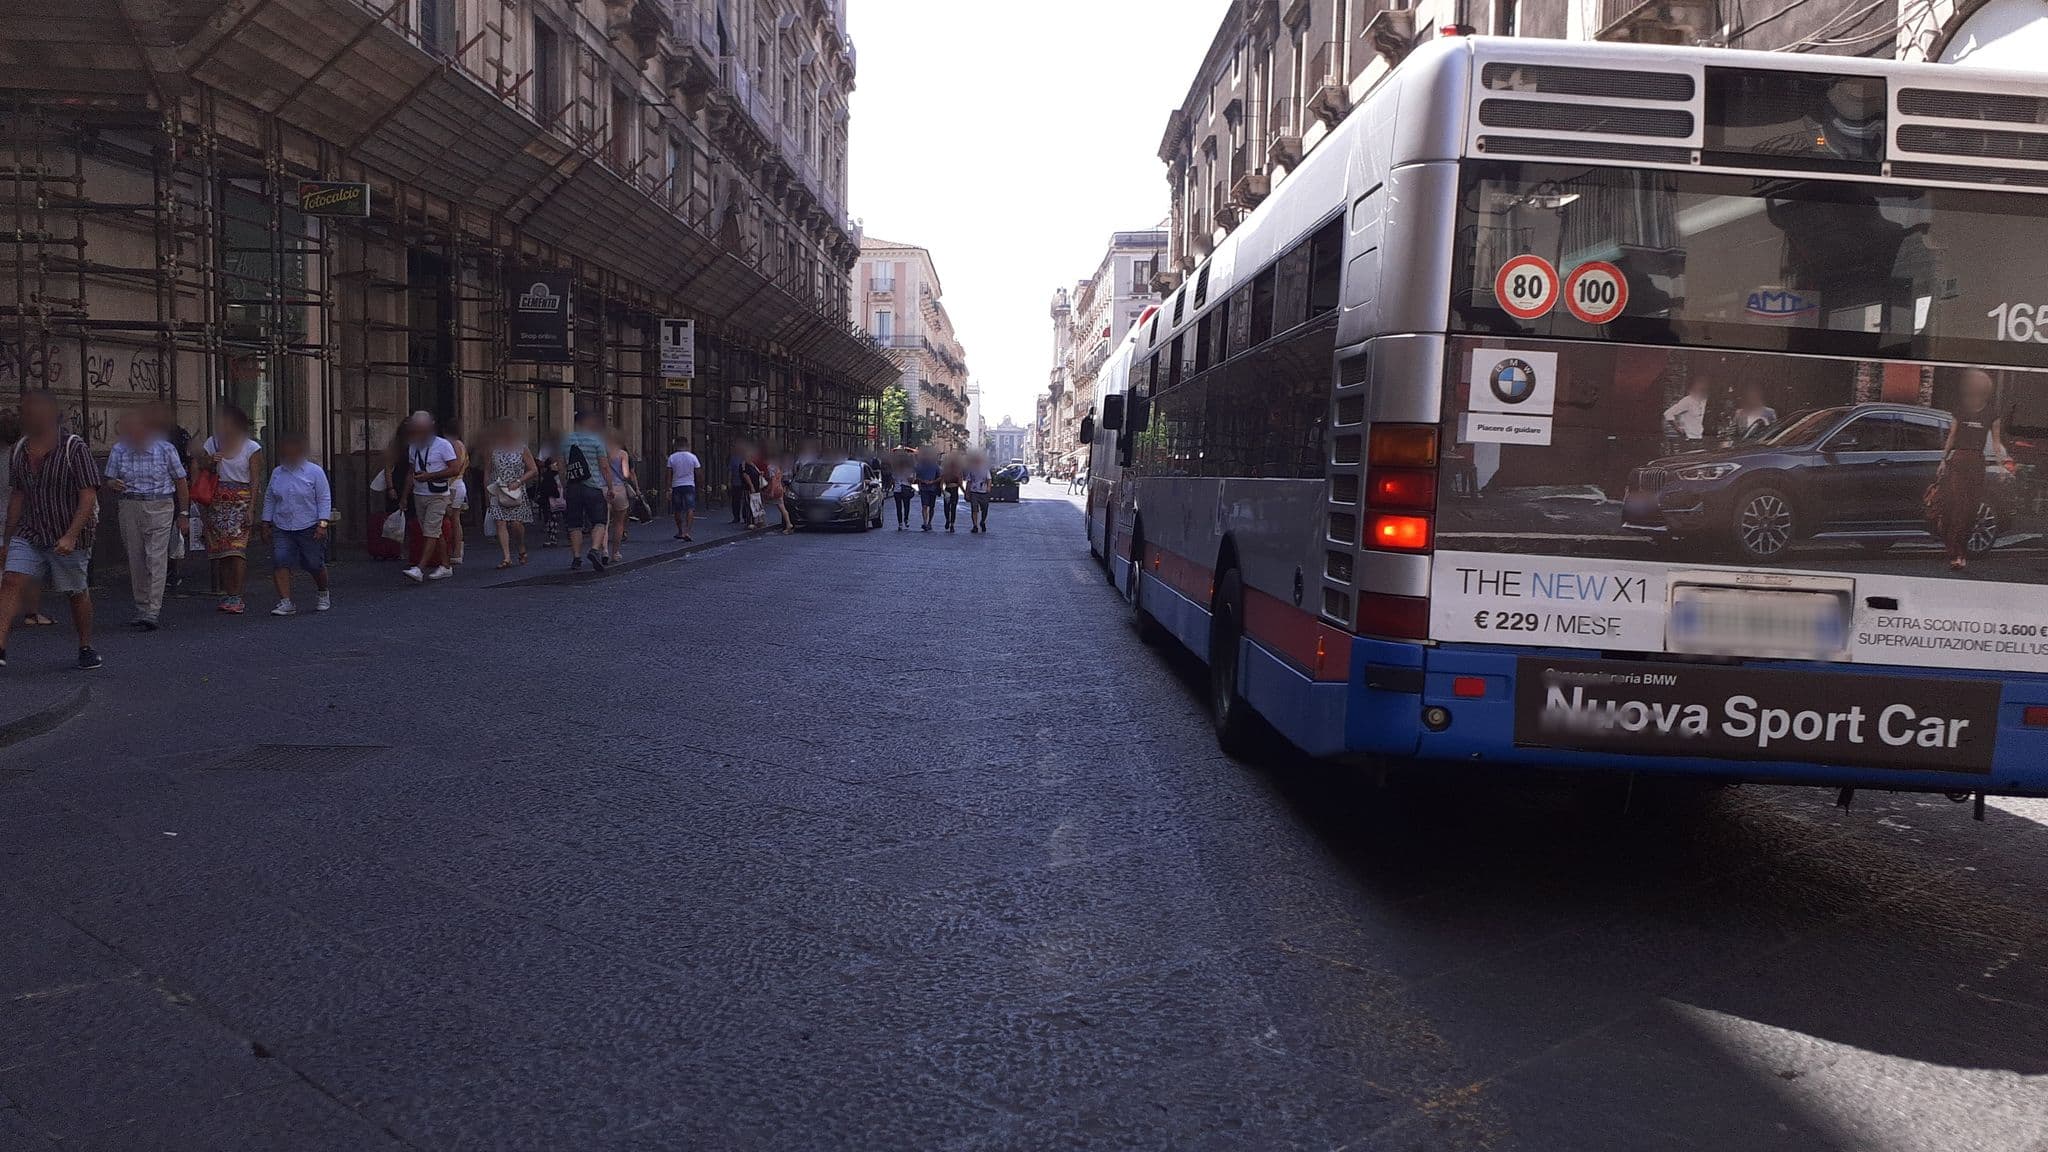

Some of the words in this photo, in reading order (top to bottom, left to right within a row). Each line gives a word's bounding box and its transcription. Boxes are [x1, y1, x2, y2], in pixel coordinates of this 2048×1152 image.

[303, 187, 361, 210] Totocalcio
[1513, 274, 1543, 299] 80
[1578, 279, 1616, 305] 100
[521, 297, 557, 309] CEMENTO
[1496, 359, 1533, 375] BMW
[1477, 423, 1505, 433] Piacere
[1505, 425, 1513, 433] di
[1513, 426, 1542, 435] guidare
[1456, 567, 1523, 598] THE
[1531, 572, 1608, 601] NEW
[1612, 576, 1647, 604] X1
[1474, 610, 1490, 630] €
[1495, 611, 1539, 632] 229
[1556, 614, 1622, 637] MESE
[1877, 616, 1921, 631] EXTRA
[1923, 618, 1980, 634] SCONTO
[1983, 622, 1996, 635] DI
[1999, 623, 2037, 637] 3.600
[1857, 632, 1993, 653] SUPERVALUTAZIONE
[1643, 673, 1677, 686] BMW
[1545, 686, 1710, 735] Nuova
[1721, 695, 1866, 748] Sport
[1876, 703, 1970, 749] Car
